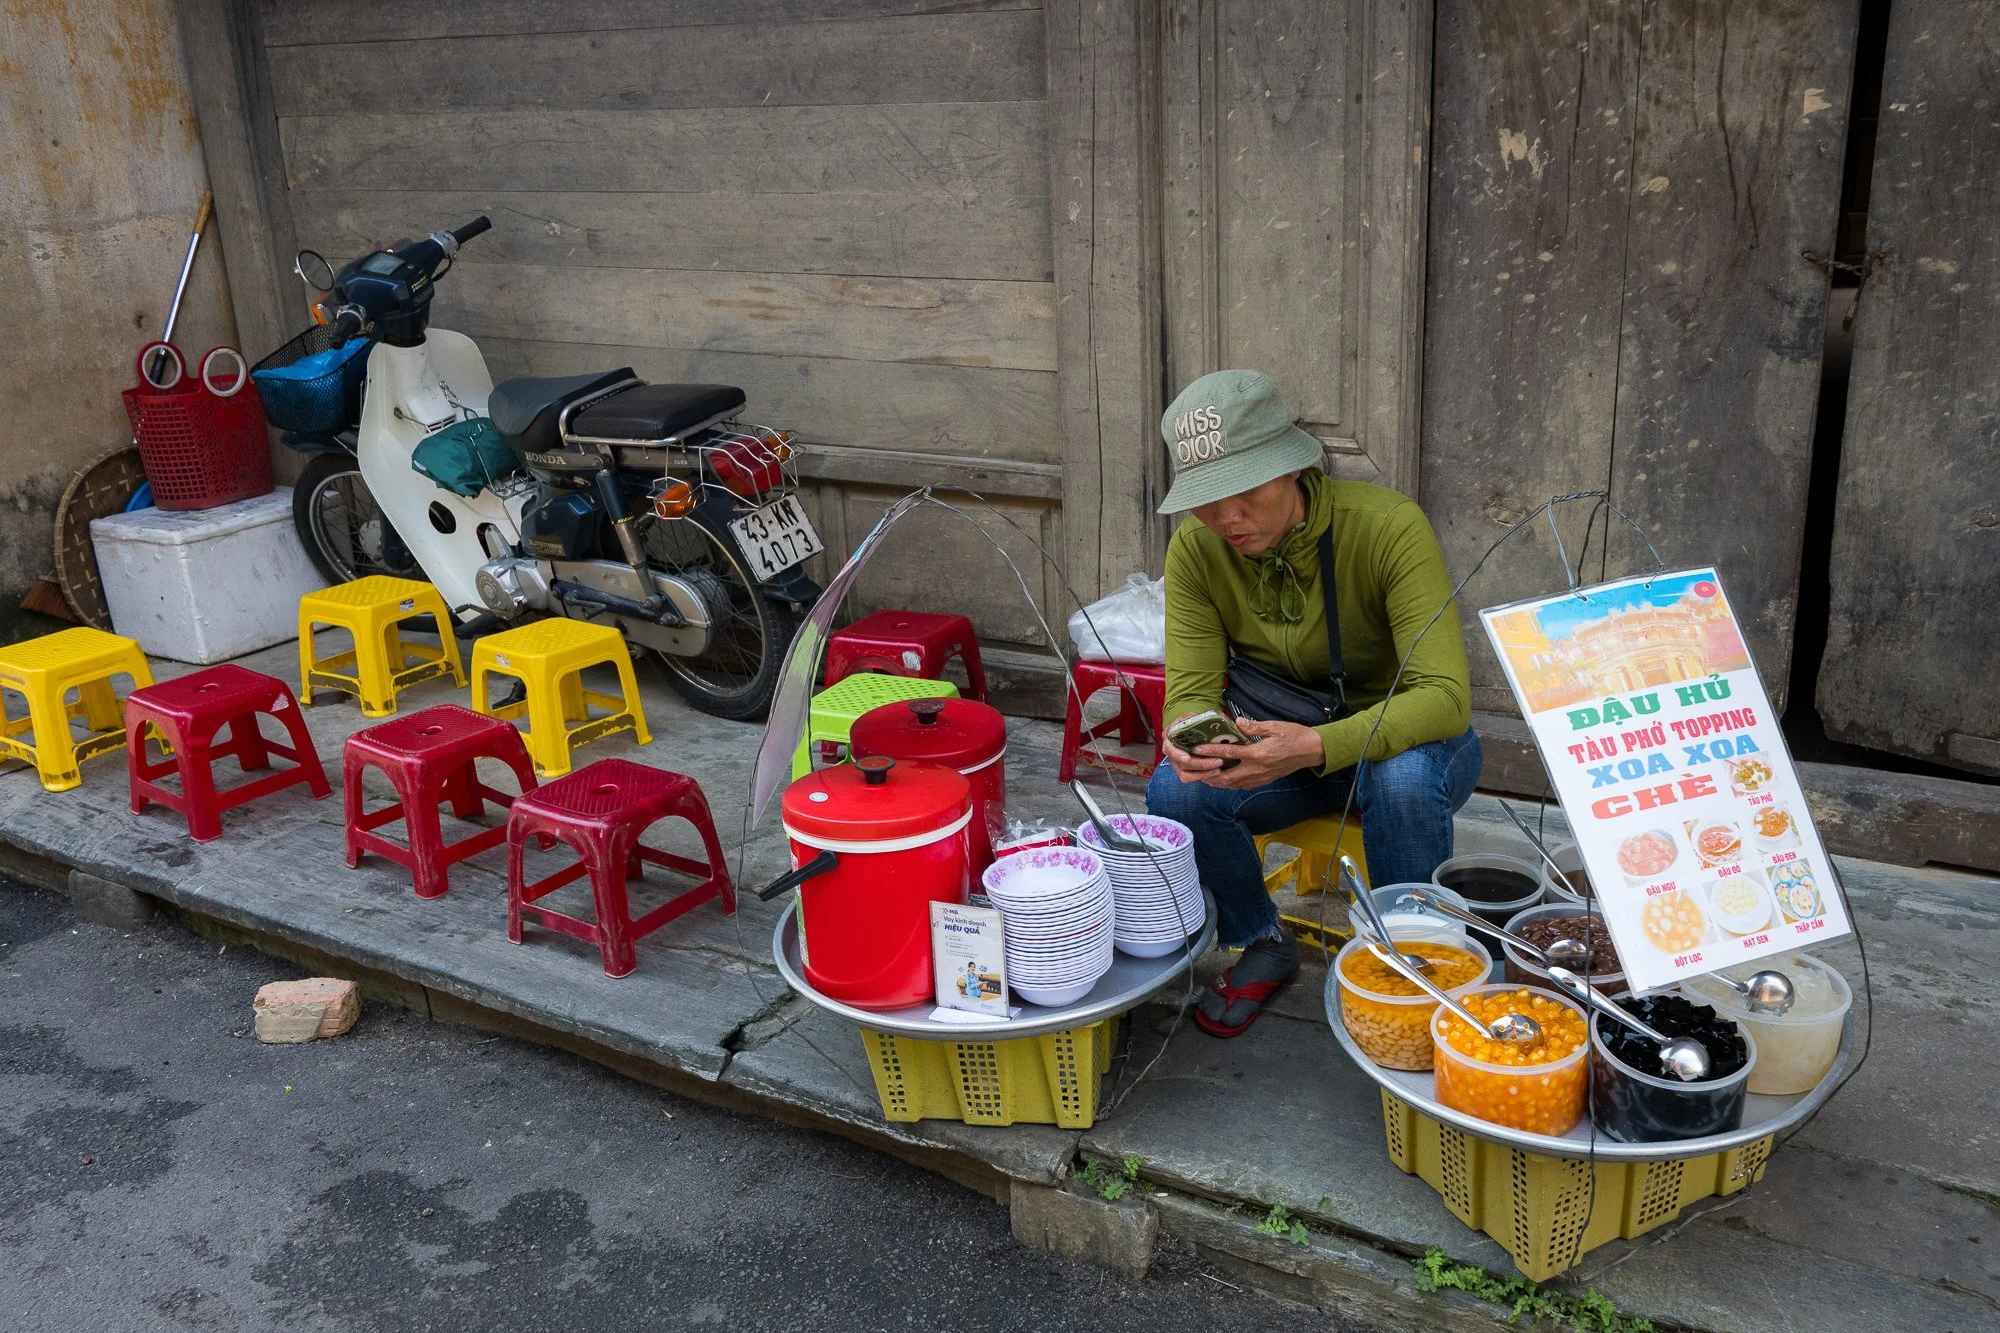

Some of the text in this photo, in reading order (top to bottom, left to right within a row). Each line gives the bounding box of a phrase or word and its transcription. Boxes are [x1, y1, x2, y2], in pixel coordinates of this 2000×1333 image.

[1175, 405, 1222, 441] MISS
[525, 452, 567, 465] HONDA
[1178, 431, 1225, 464] DIOR
[760, 528, 813, 572] 4073
[1566, 673, 1732, 731] ĐẬU HỦ
[1567, 735, 1618, 764] TÀU
[1670, 707, 1757, 740] TOPPING
[1586, 734, 1760, 789] XOA XOA
[1591, 772, 1718, 820] CHÈ
[944, 923, 962, 932] HIỆU
[955, 917, 968, 925] kinh
[968, 920, 987, 928] doanh
